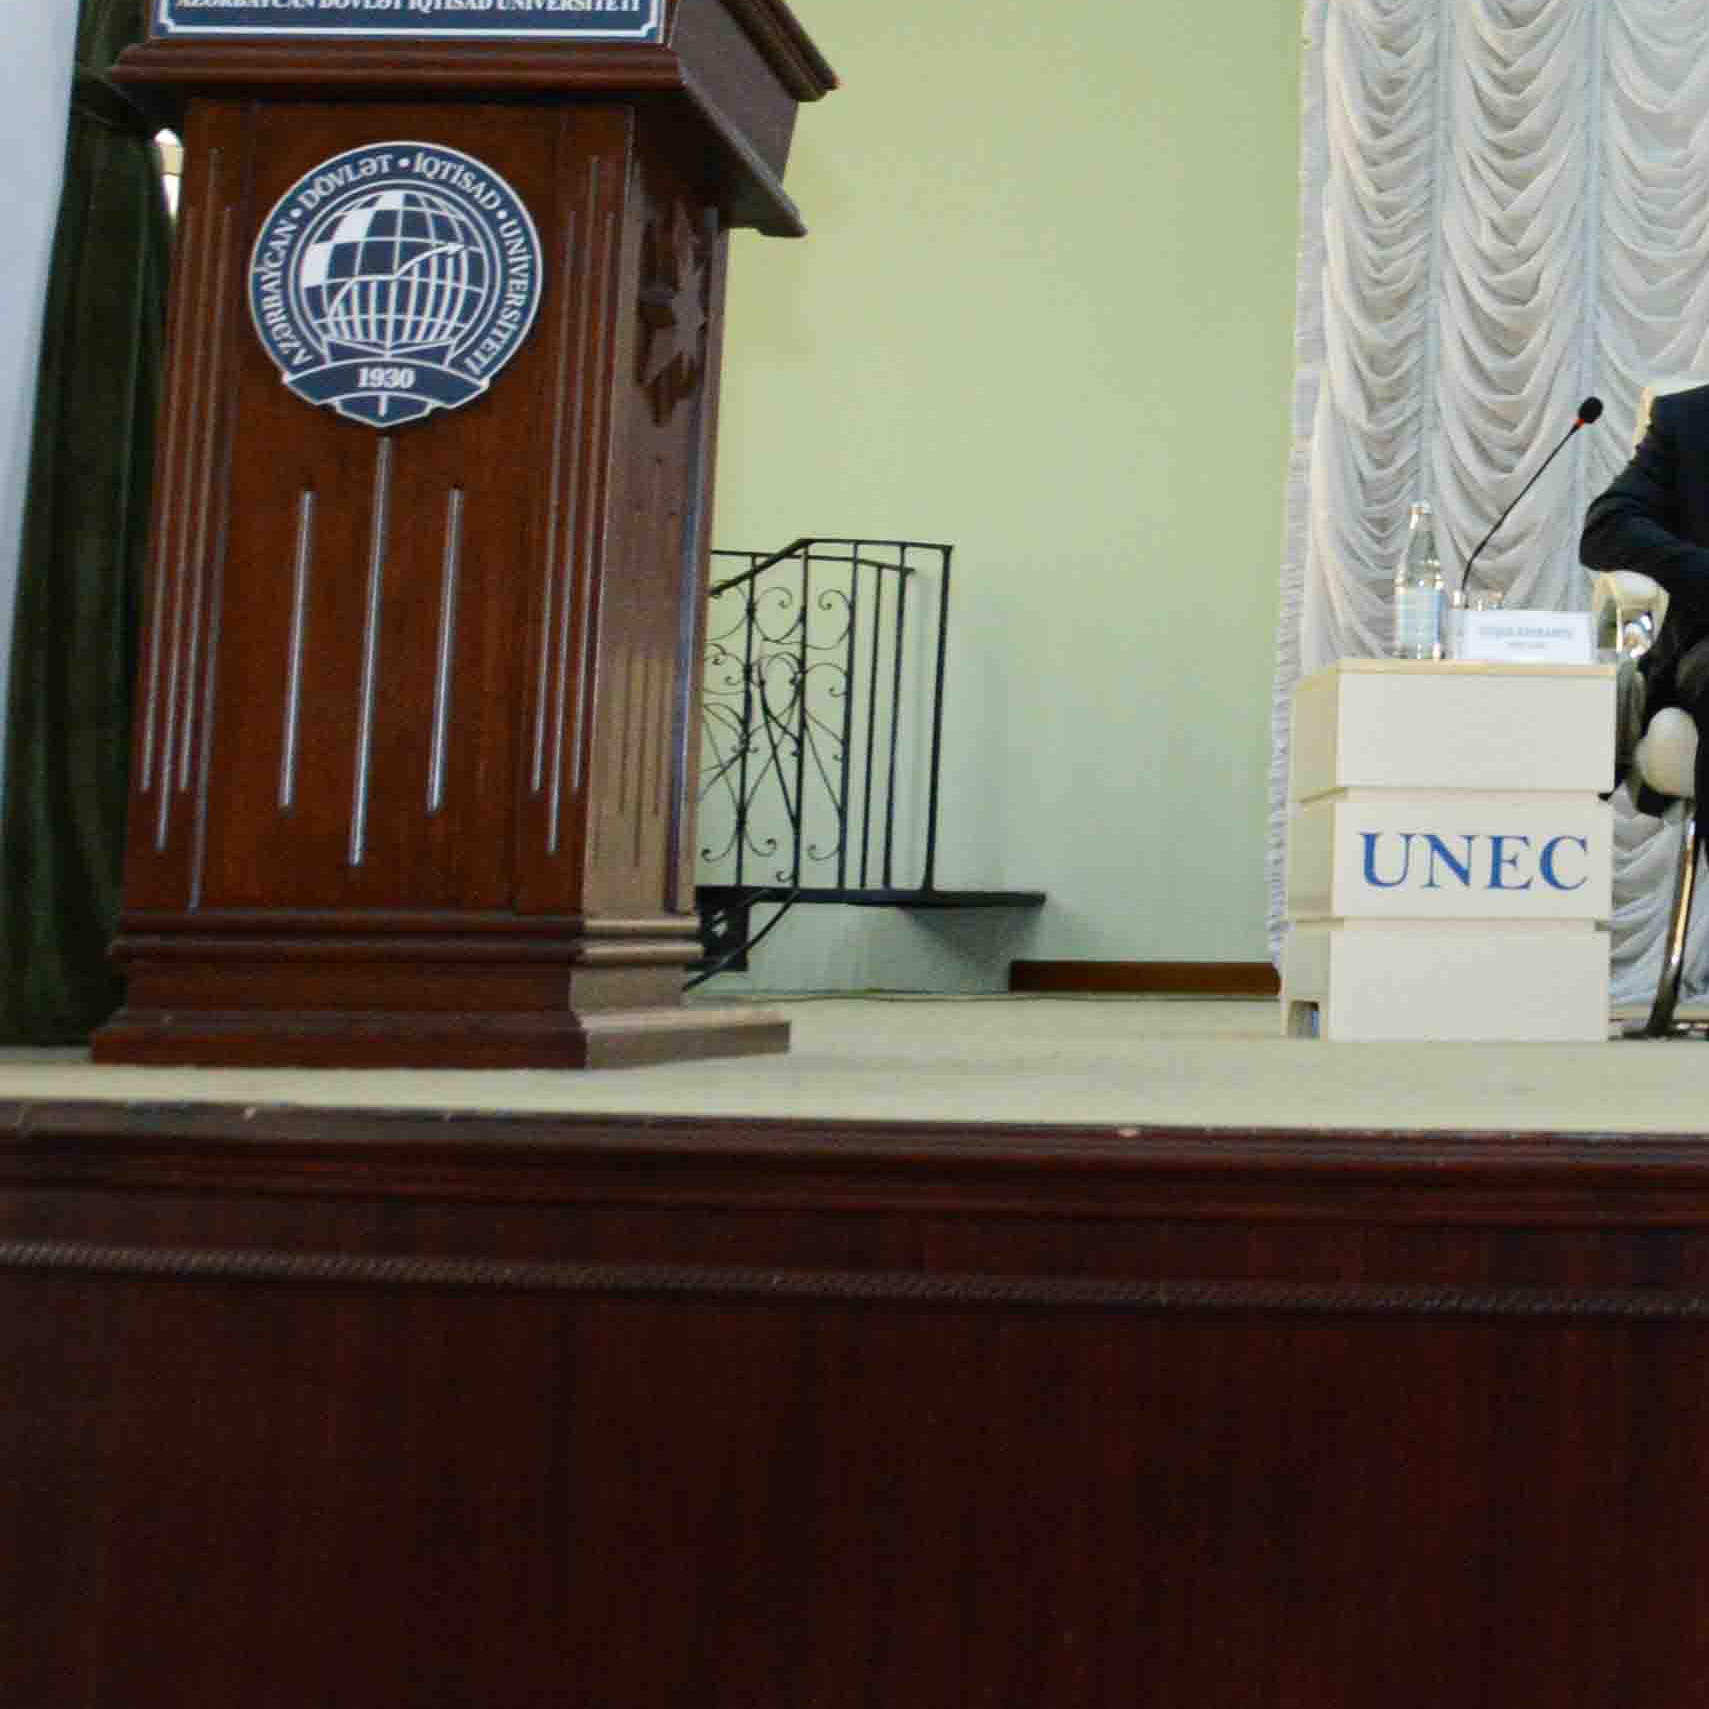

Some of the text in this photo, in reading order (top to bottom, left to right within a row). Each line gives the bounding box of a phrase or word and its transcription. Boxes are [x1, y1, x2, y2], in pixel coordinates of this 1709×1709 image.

[297, 153, 394, 210] DÖVLƏT
[411, 151, 500, 211] İQTİSAD
[463, 217, 533, 376] UNİVERSİTETİ
[357, 366, 416, 389] 1930
[1359, 832, 1588, 891] UNEC
